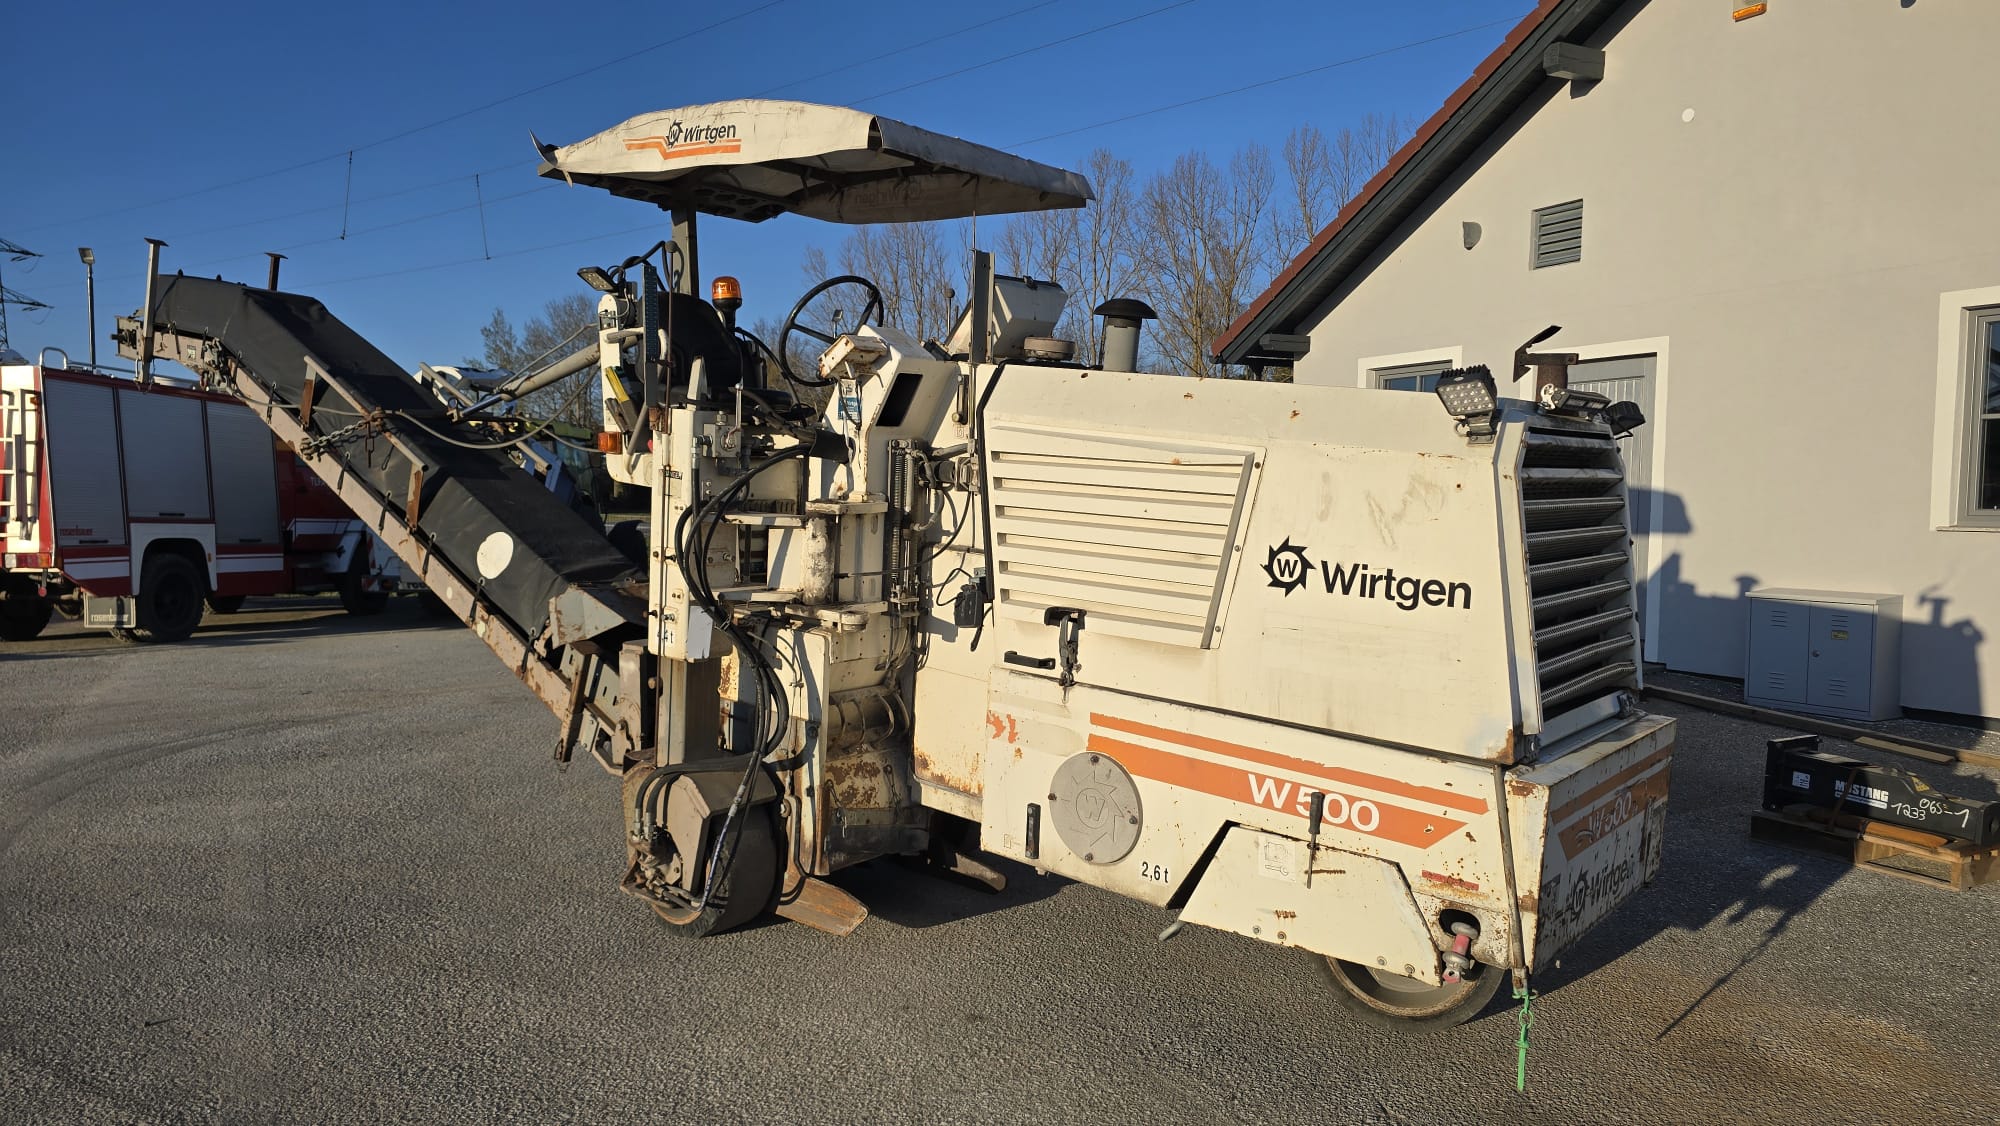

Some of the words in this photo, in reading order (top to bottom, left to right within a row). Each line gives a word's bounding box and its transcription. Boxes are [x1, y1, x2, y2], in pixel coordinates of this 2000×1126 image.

[684, 124, 737, 144] Wirtgen
[1276, 558, 1299, 579] W
[1320, 559, 1472, 611] Wirtgen
[1141, 861, 1161, 881] 2,6
[1164, 867, 1170, 883] t
